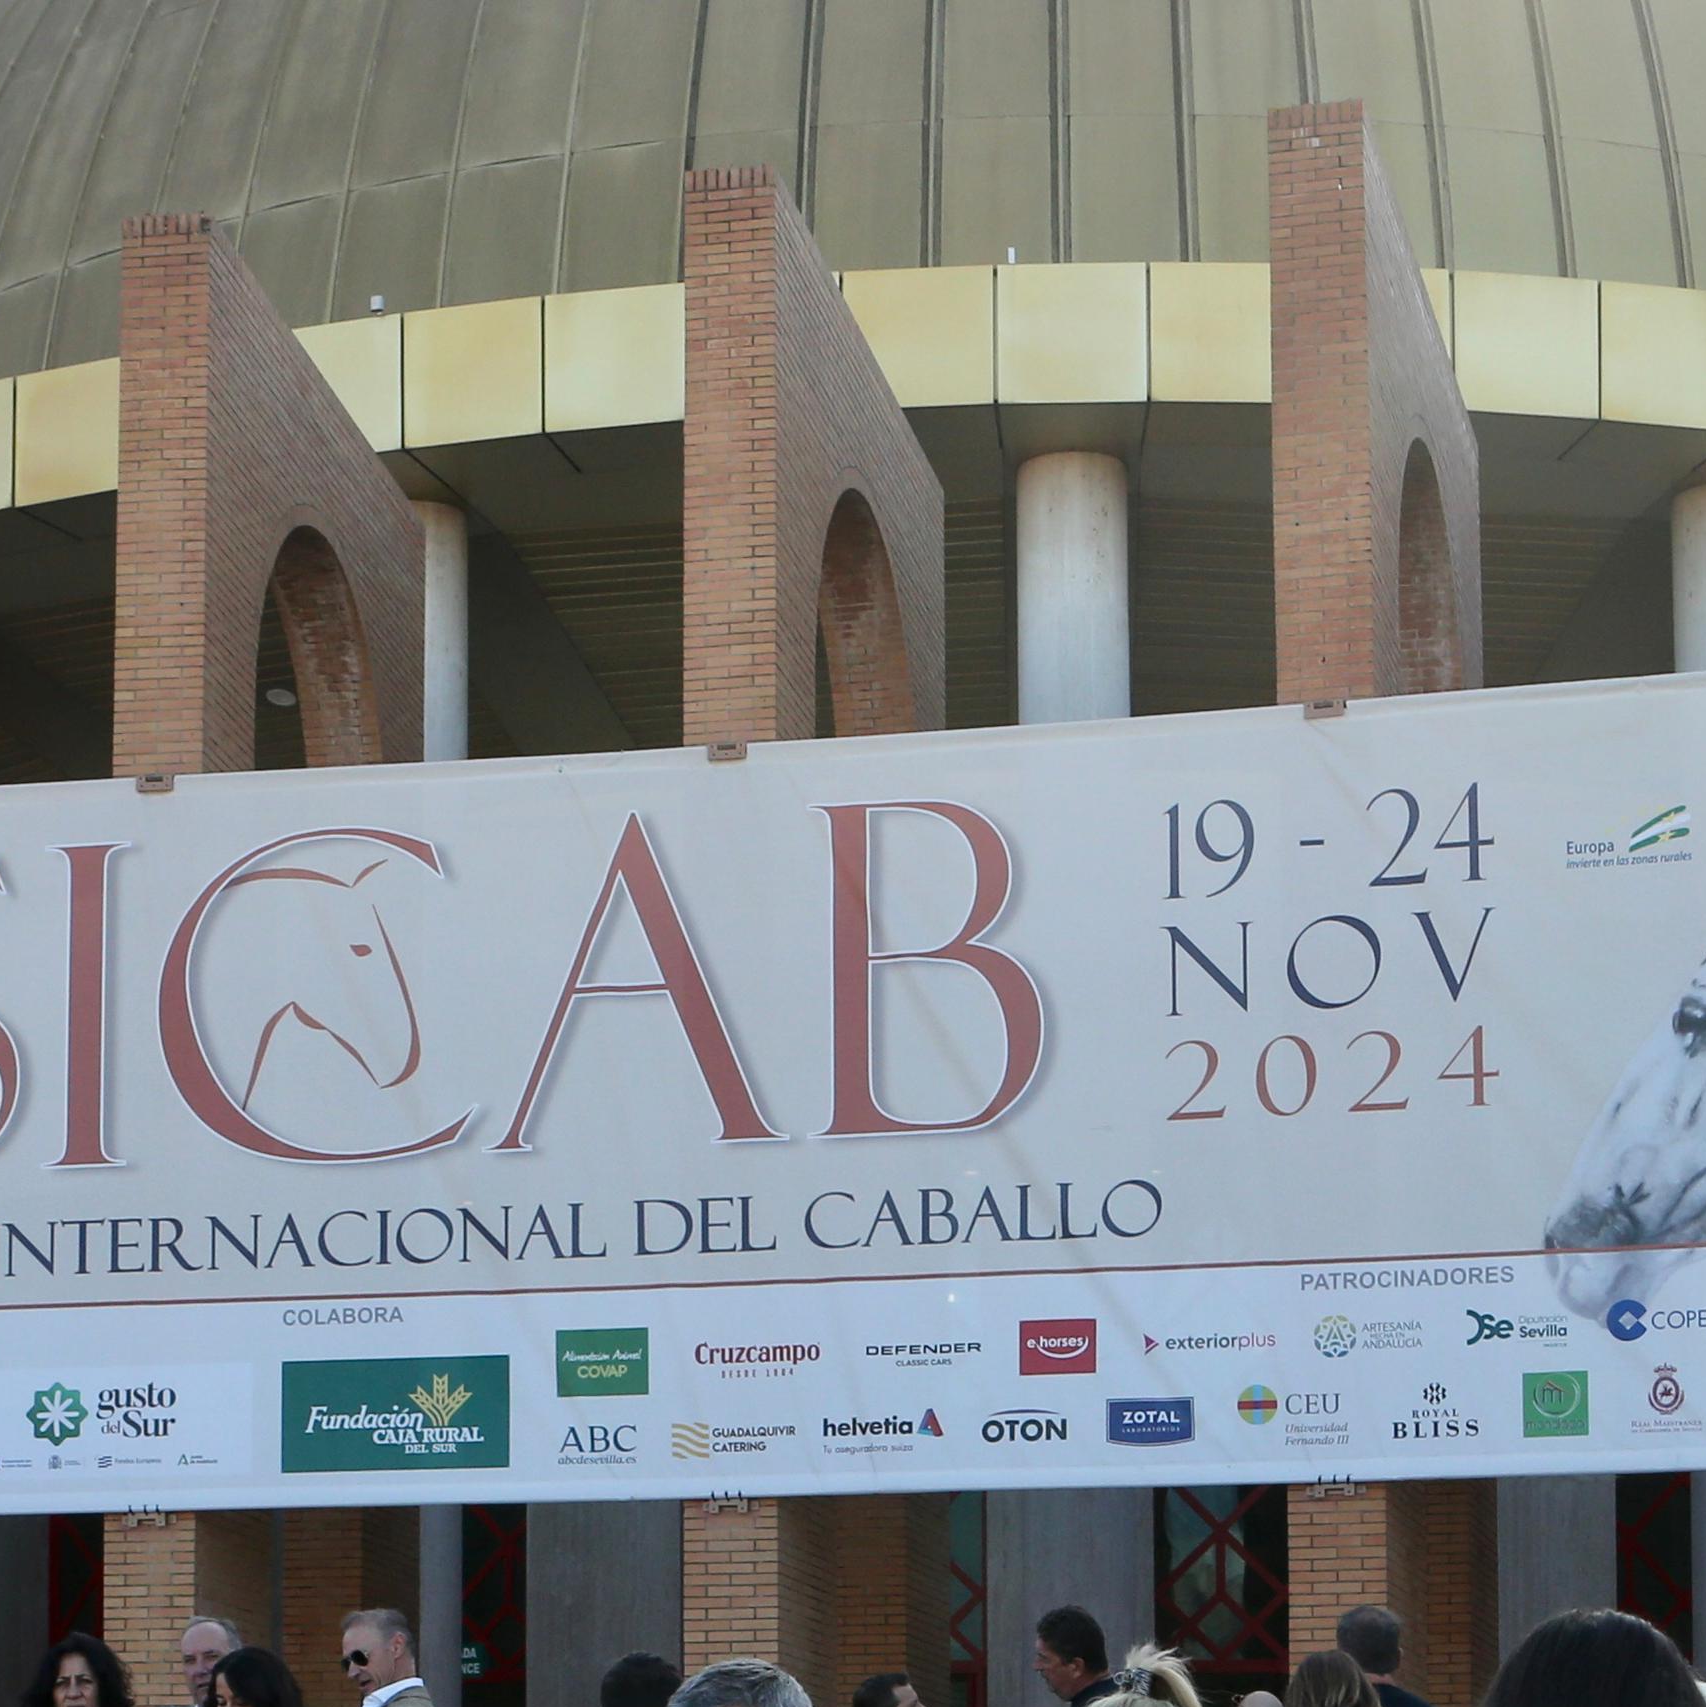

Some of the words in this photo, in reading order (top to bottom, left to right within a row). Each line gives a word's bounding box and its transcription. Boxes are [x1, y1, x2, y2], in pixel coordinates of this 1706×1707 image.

[1162, 799, 1255, 900] 19
[1365, 781, 1495, 888] 24
[1566, 841, 1615, 856] Europa
[1566, 858, 1602, 869] invierte
[1603, 858, 1614, 867] en
[1616, 855, 1629, 866] las
[1632, 855, 1658, 865] zonas
[1660, 851, 1692, 863] rurales
[1160, 907, 1496, 1017] NOV
[1165, 1025, 1500, 1121] 2024
[633, 1195, 778, 1258] DEL
[803, 1178, 1164, 1250] CABALLO
[1300, 1265, 1515, 1291] PATROCINADORES
[282, 1306, 404, 1326] COLABORA
[1361, 1320, 1422, 1333] ARTESANÍA
[1519, 1324, 1568, 1338] Sevilla
[865, 1342, 982, 1357] DEFENDER
[1165, 1333, 1276, 1350] exteriorplus
[1361, 1337, 1423, 1349] ANDALUCÍA
[694, 1341, 820, 1366] Cruzcampo
[577, 1364, 628, 1378] COVAP
[895, 1359, 929, 1367] CLASSIC
[931, 1358, 953, 1367] CARS
[96, 1381, 177, 1420] gusto
[1285, 1393, 1341, 1415] CEU
[305, 1404, 424, 1433] Fundación
[1122, 1410, 1181, 1424] ZOTAL
[1412, 1408, 1459, 1419] ROYAL
[100, 1420, 121, 1435] del
[122, 1410, 177, 1438] Sur
[712, 1425, 796, 1439] GUADALQUIVIR
[823, 1415, 913, 1437] helvetia
[981, 1418, 1068, 1443] OTON
[1284, 1422, 1349, 1434] Universidad
[1393, 1418, 1480, 1440] BLISS
[372, 1428, 419, 1445] CAJA
[421, 1426, 485, 1443] RURAL
[559, 1425, 638, 1454] ABC
[1284, 1435, 1335, 1446] Fernando
[1337, 1435, 1350, 1445] III
[404, 1444, 429, 1454] DEL
[431, 1443, 457, 1453] SUR
[712, 1441, 767, 1453] CATERING
[834, 1443, 888, 1455] aseguradora
[557, 1454, 637, 1465] abcdesevilla.es
